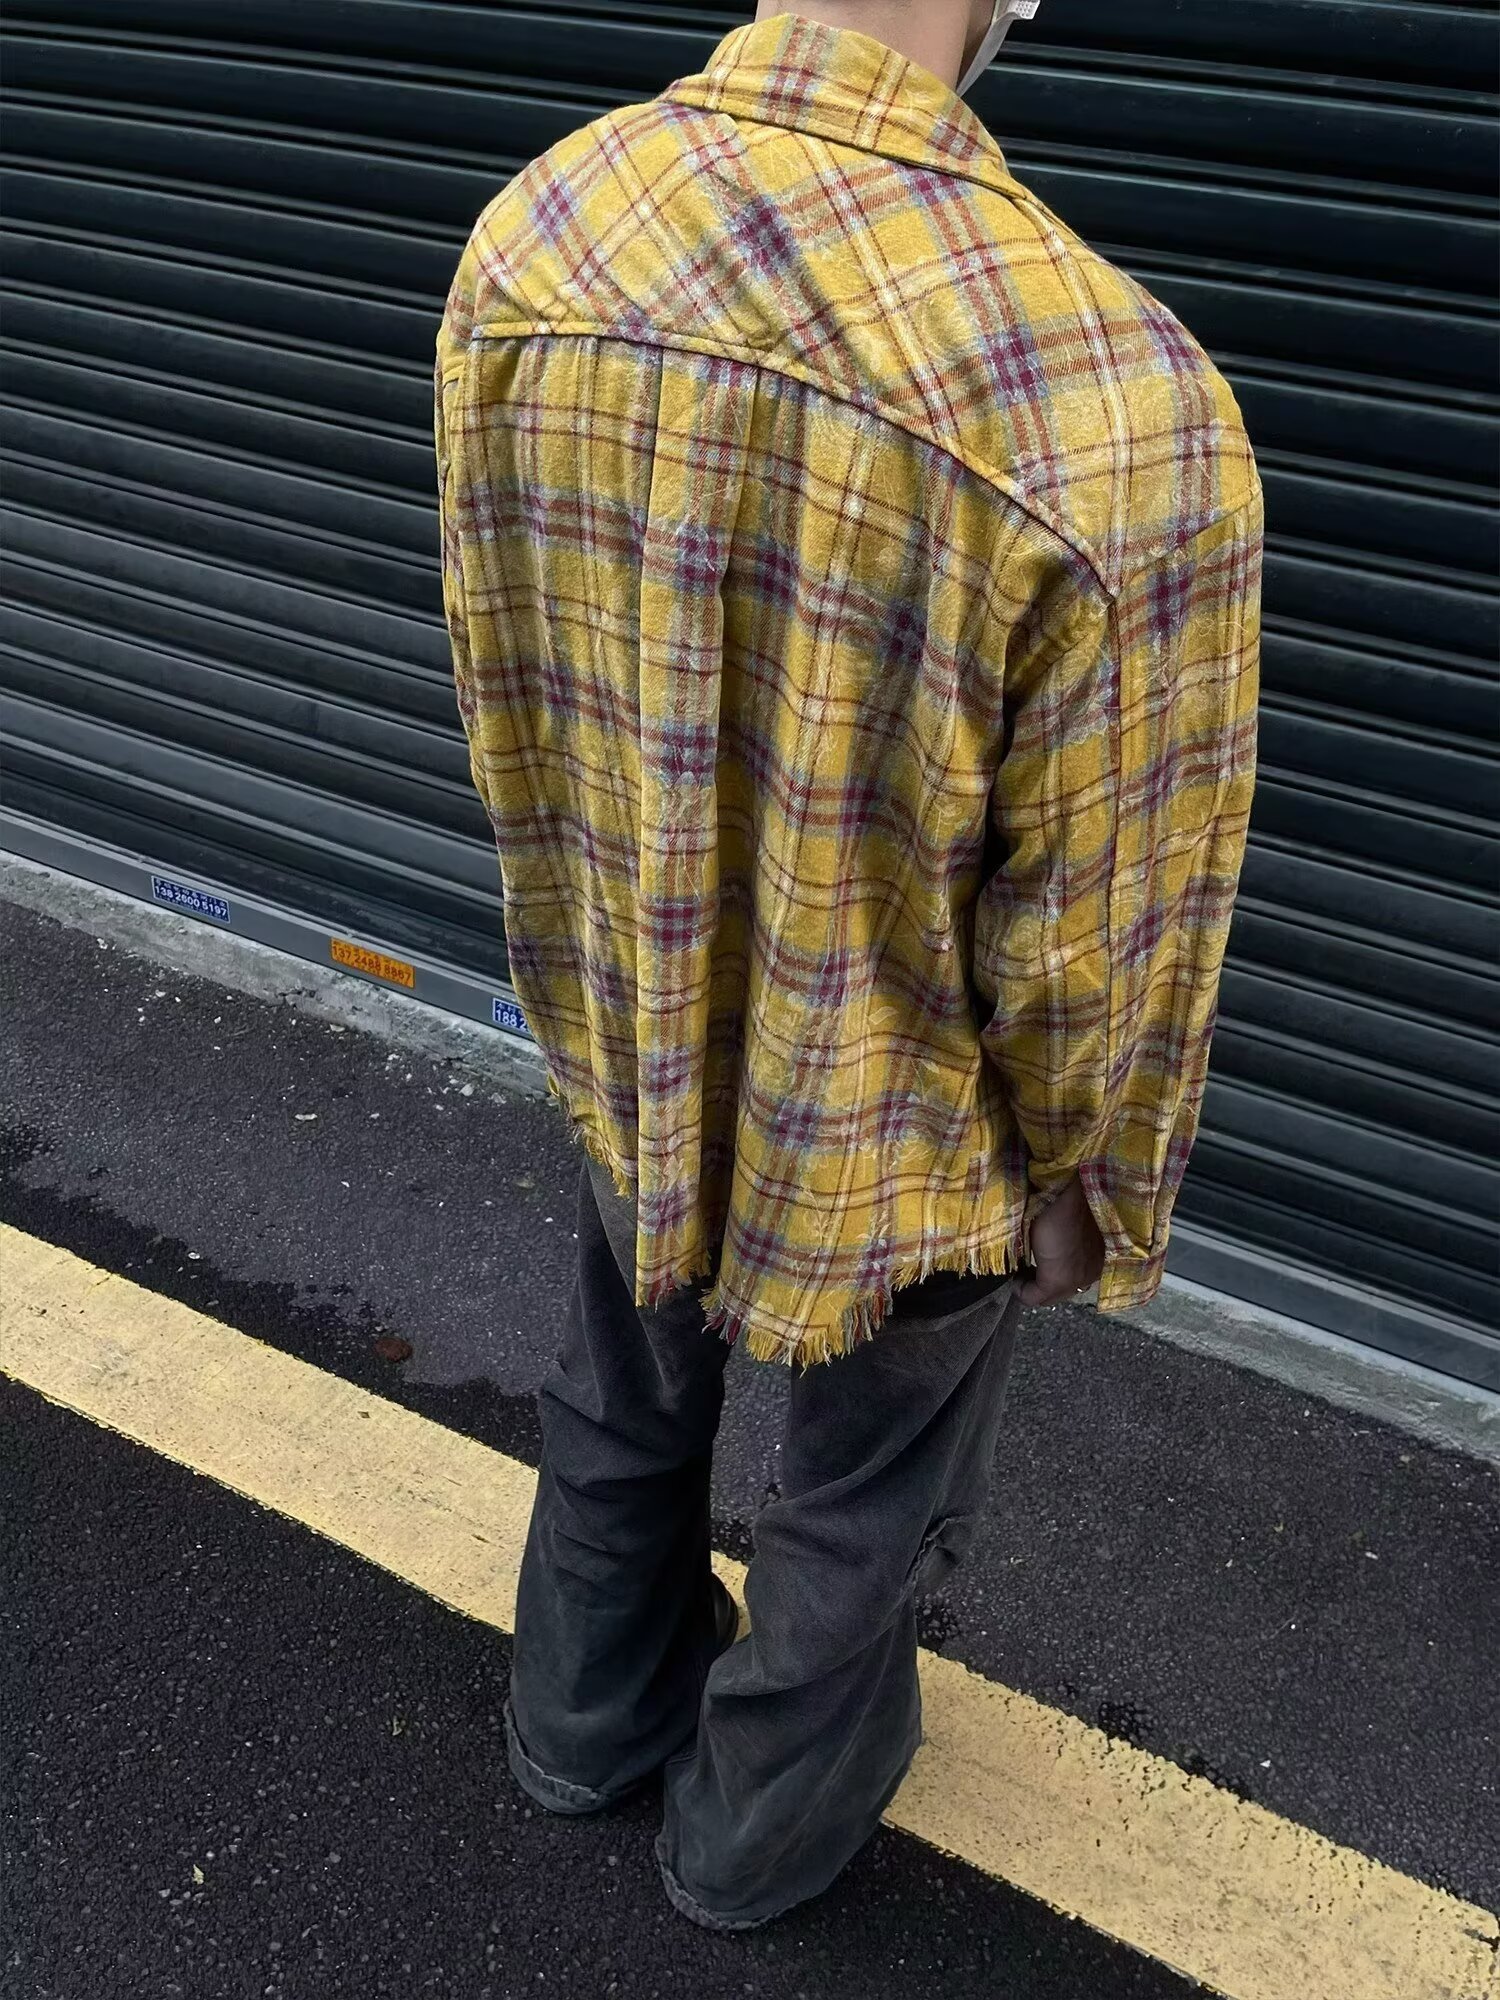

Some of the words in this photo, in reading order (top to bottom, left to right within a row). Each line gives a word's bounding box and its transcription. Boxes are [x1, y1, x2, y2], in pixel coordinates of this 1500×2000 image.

[155, 886, 173, 898] 138
[202, 901, 227, 916] 5197
[333, 946, 351, 960] 137
[496, 1009, 517, 1027] 188
